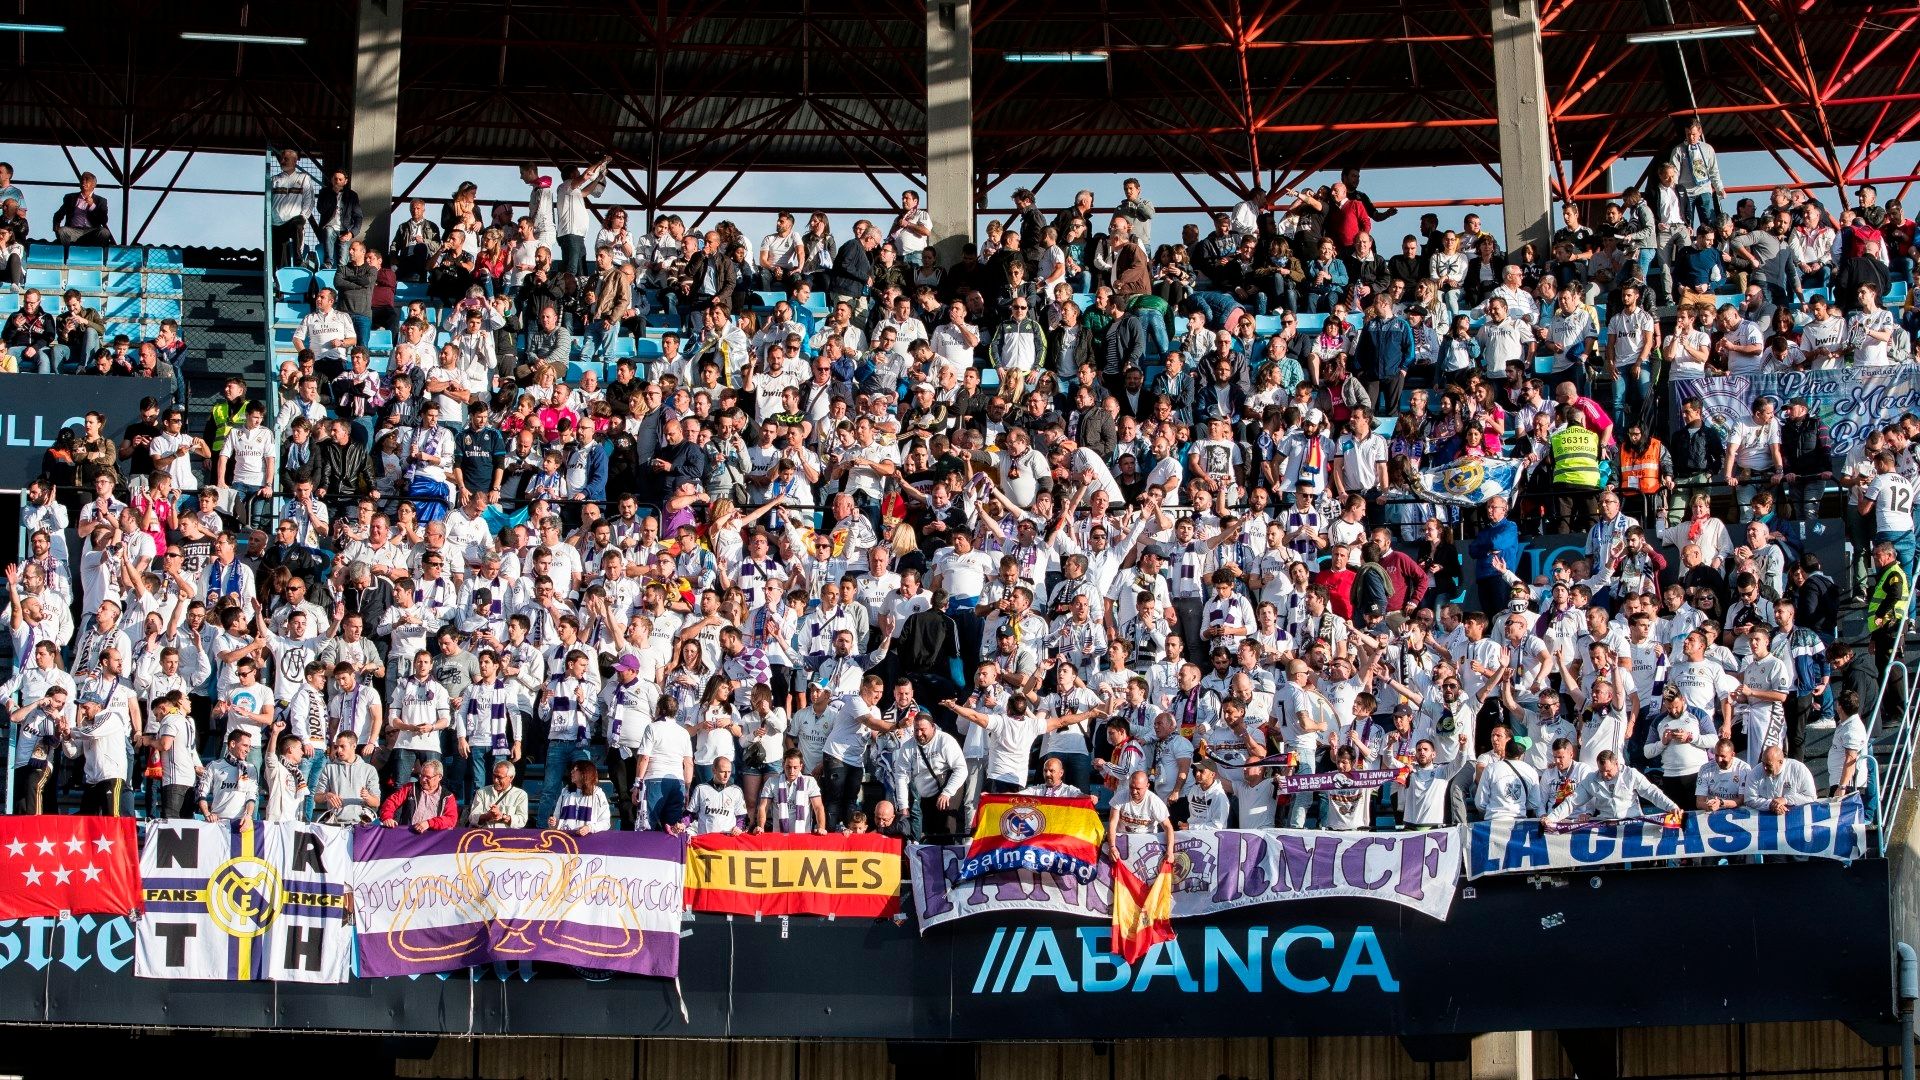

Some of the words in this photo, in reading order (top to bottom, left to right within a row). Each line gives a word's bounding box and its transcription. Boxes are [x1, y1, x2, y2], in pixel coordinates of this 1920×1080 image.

[1561, 436, 1589, 445] 36315
[751, 464, 769, 472] bwi
[1890, 485, 1911, 514] 12
[23, 724, 40, 737] bwi
[220, 780, 237, 790] bwi
[1300, 776, 1333, 786] CLASICA
[705, 806, 730, 817] bwin
[1470, 819, 1550, 876] LA
[1568, 801, 1866, 863] CLASICA
[696, 853, 884, 890] TIELMES
[960, 849, 1096, 879] ealmadrid
[1210, 830, 1450, 903] RMCF
[560, 857, 682, 914] blanca
[147, 889, 198, 901] FANS
[287, 893, 342, 906] RMCF
